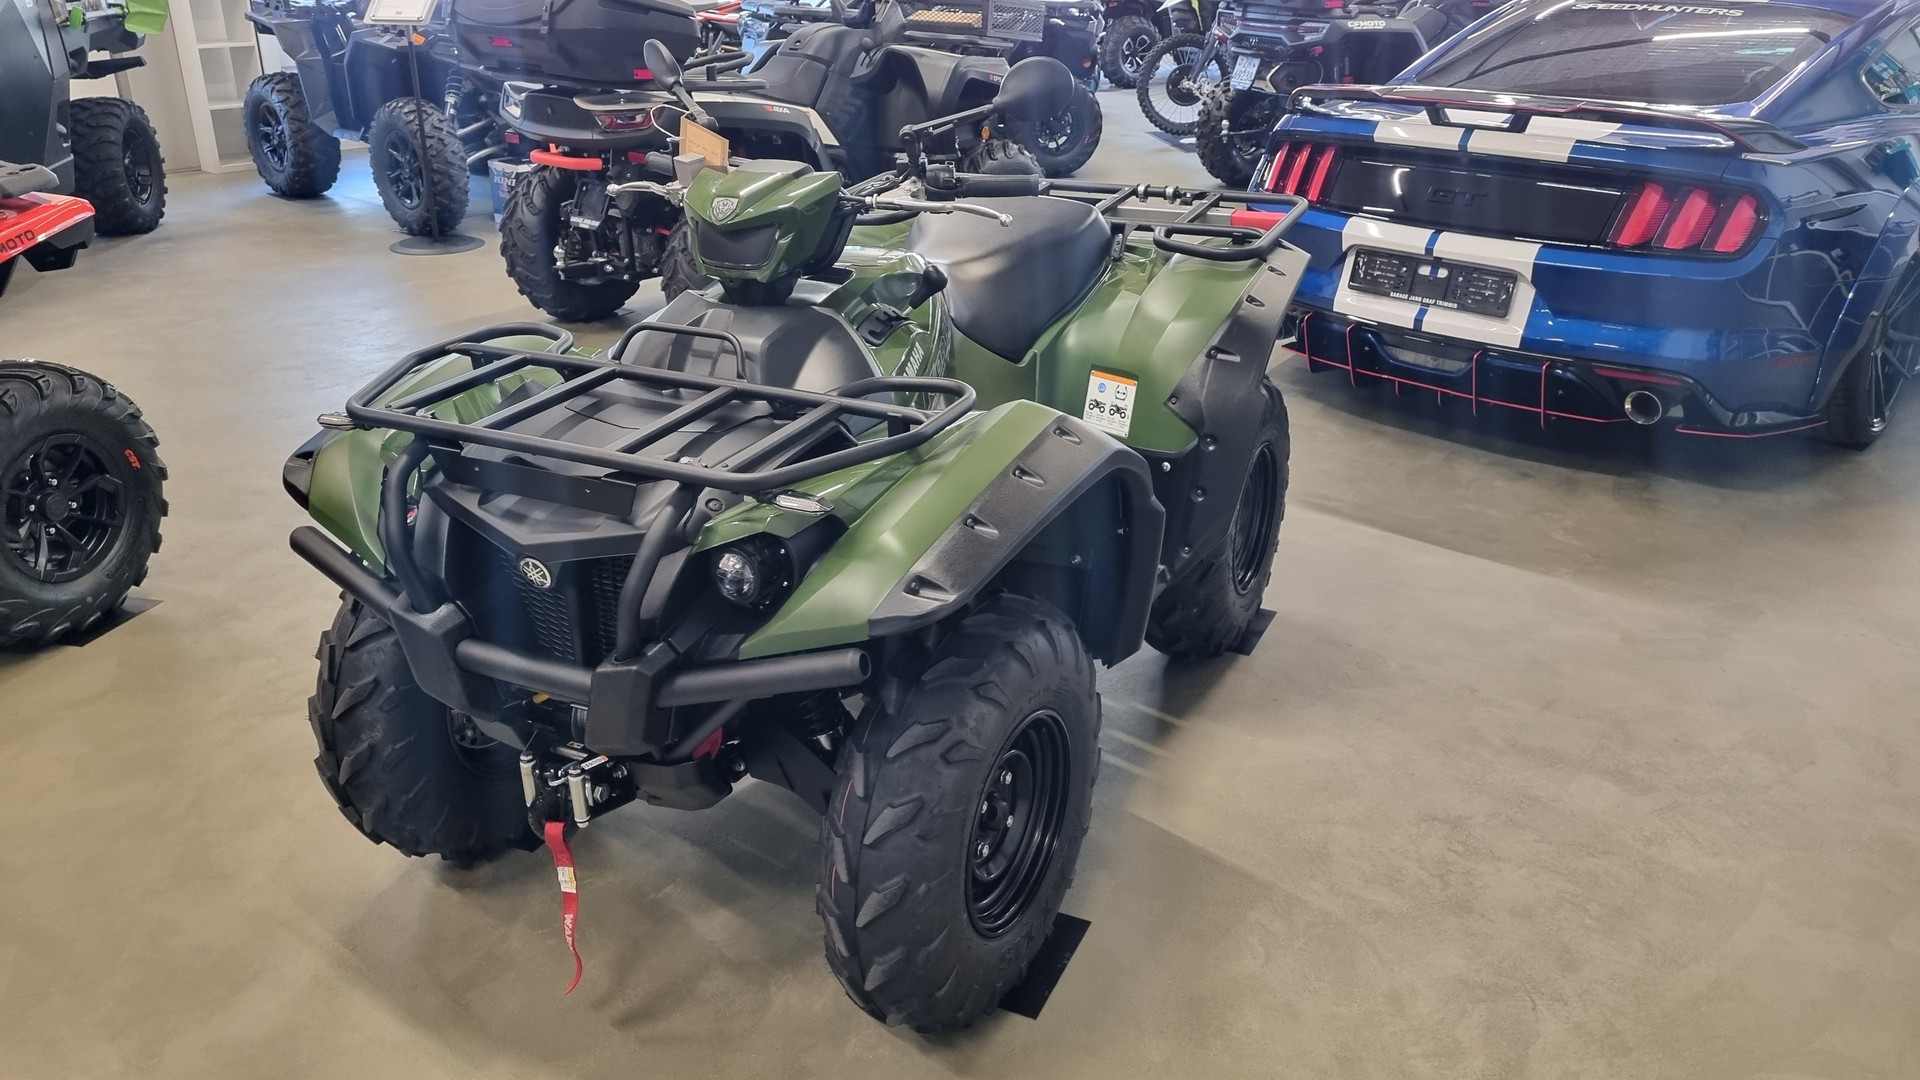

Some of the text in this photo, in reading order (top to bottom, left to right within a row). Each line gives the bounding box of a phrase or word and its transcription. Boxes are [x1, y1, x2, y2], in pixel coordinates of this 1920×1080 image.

[1571, 3, 1745, 17] SPEEDHUNTERS
[1427, 189, 1488, 207] GT
[1389, 291, 1409, 300] GARAGE
[1436, 299, 1458, 309] TRIMMIS
